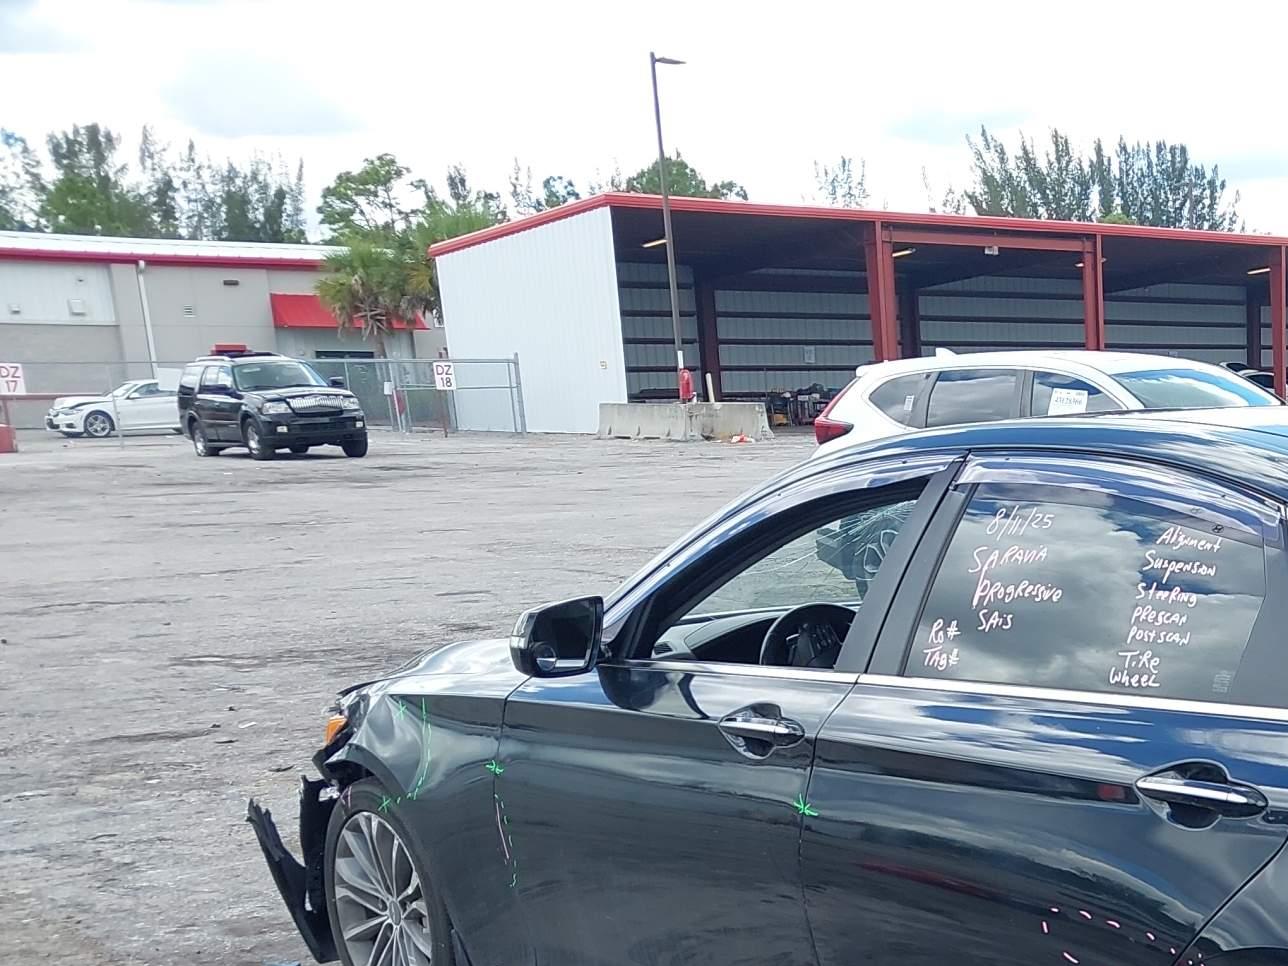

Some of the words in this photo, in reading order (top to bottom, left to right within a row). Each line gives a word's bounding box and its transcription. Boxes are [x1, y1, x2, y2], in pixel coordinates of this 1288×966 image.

[435, 364, 453, 376] DZ
[6, 380, 18, 392] 17
[440, 376, 453, 388] 18
[986, 505, 1055, 541] 8/11/25
